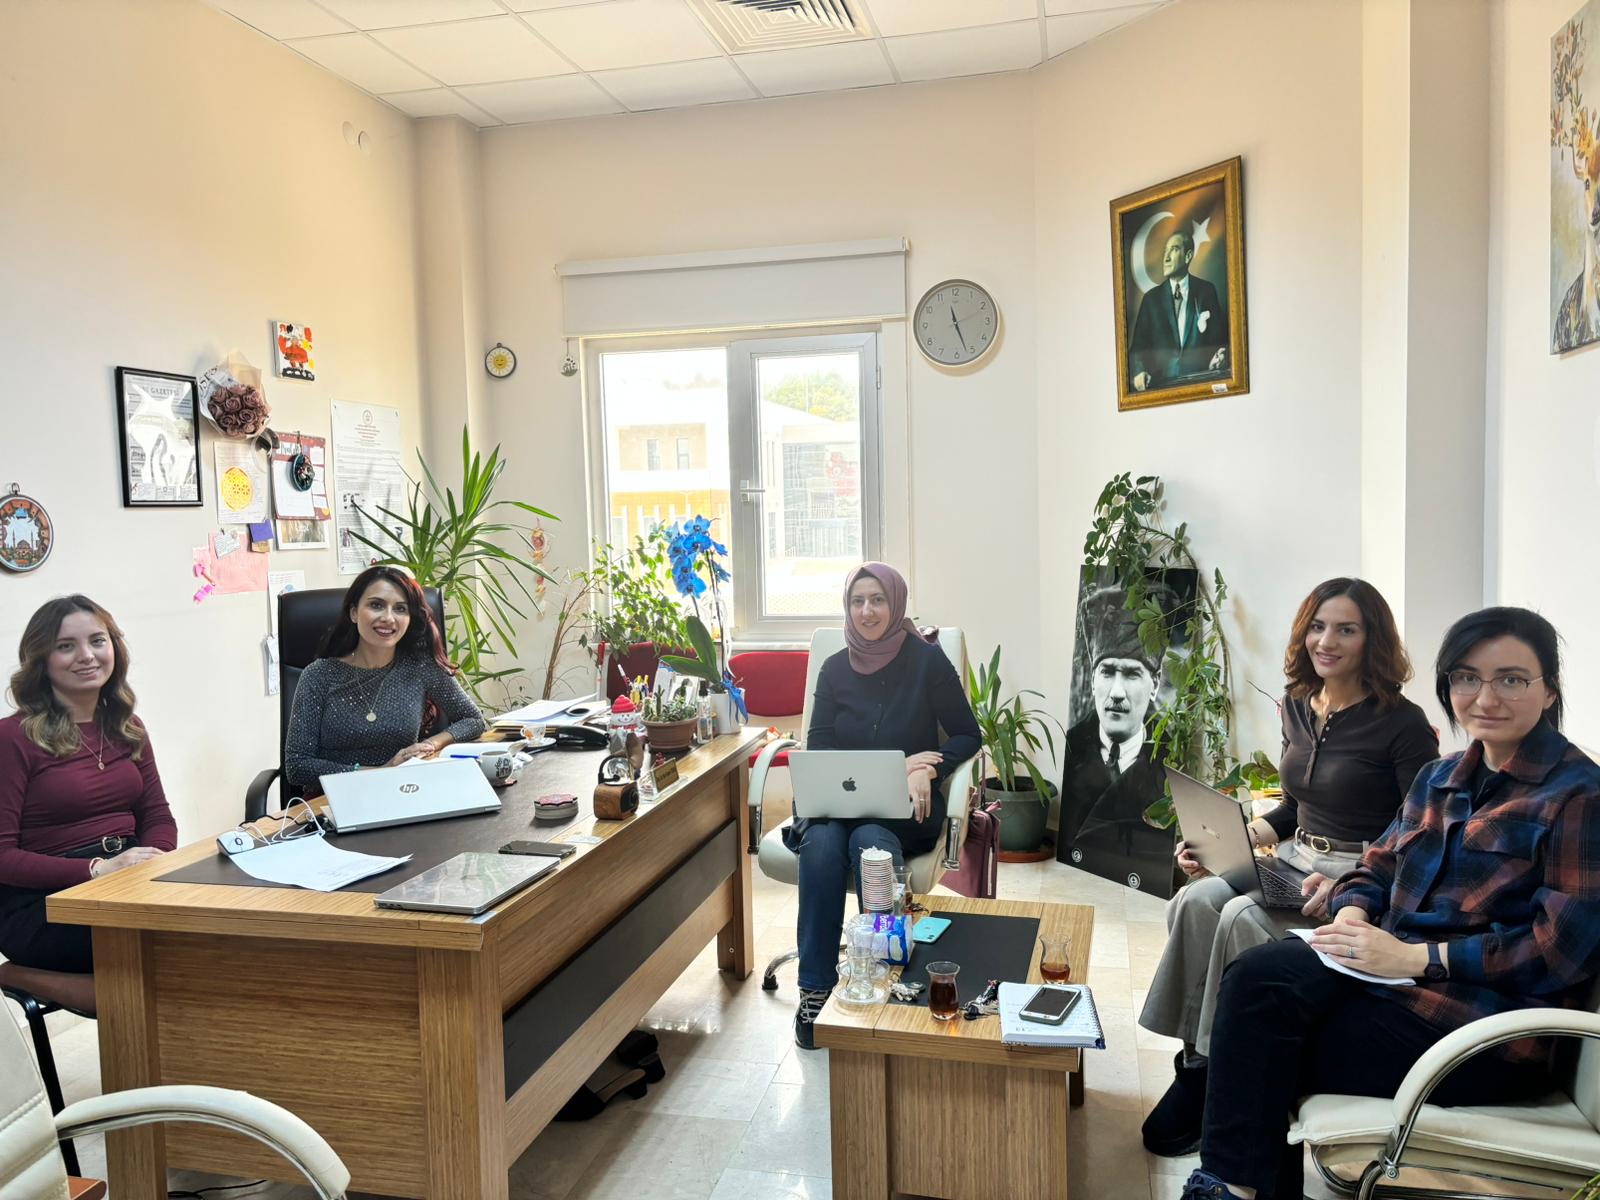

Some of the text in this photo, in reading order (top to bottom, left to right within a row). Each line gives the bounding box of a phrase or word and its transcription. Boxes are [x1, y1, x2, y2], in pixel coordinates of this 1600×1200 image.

[951, 288, 959, 297] 12
[937, 293, 944, 302] 11
[926, 306, 933, 314] 10
[980, 302, 986, 310] 2
[985, 317, 991, 326] 3
[927, 338, 933, 346] 8
[981, 334, 987, 342] 4
[938, 348, 944, 356] 7
[970, 346, 976, 354] 5
[401, 784, 418, 793] hp
